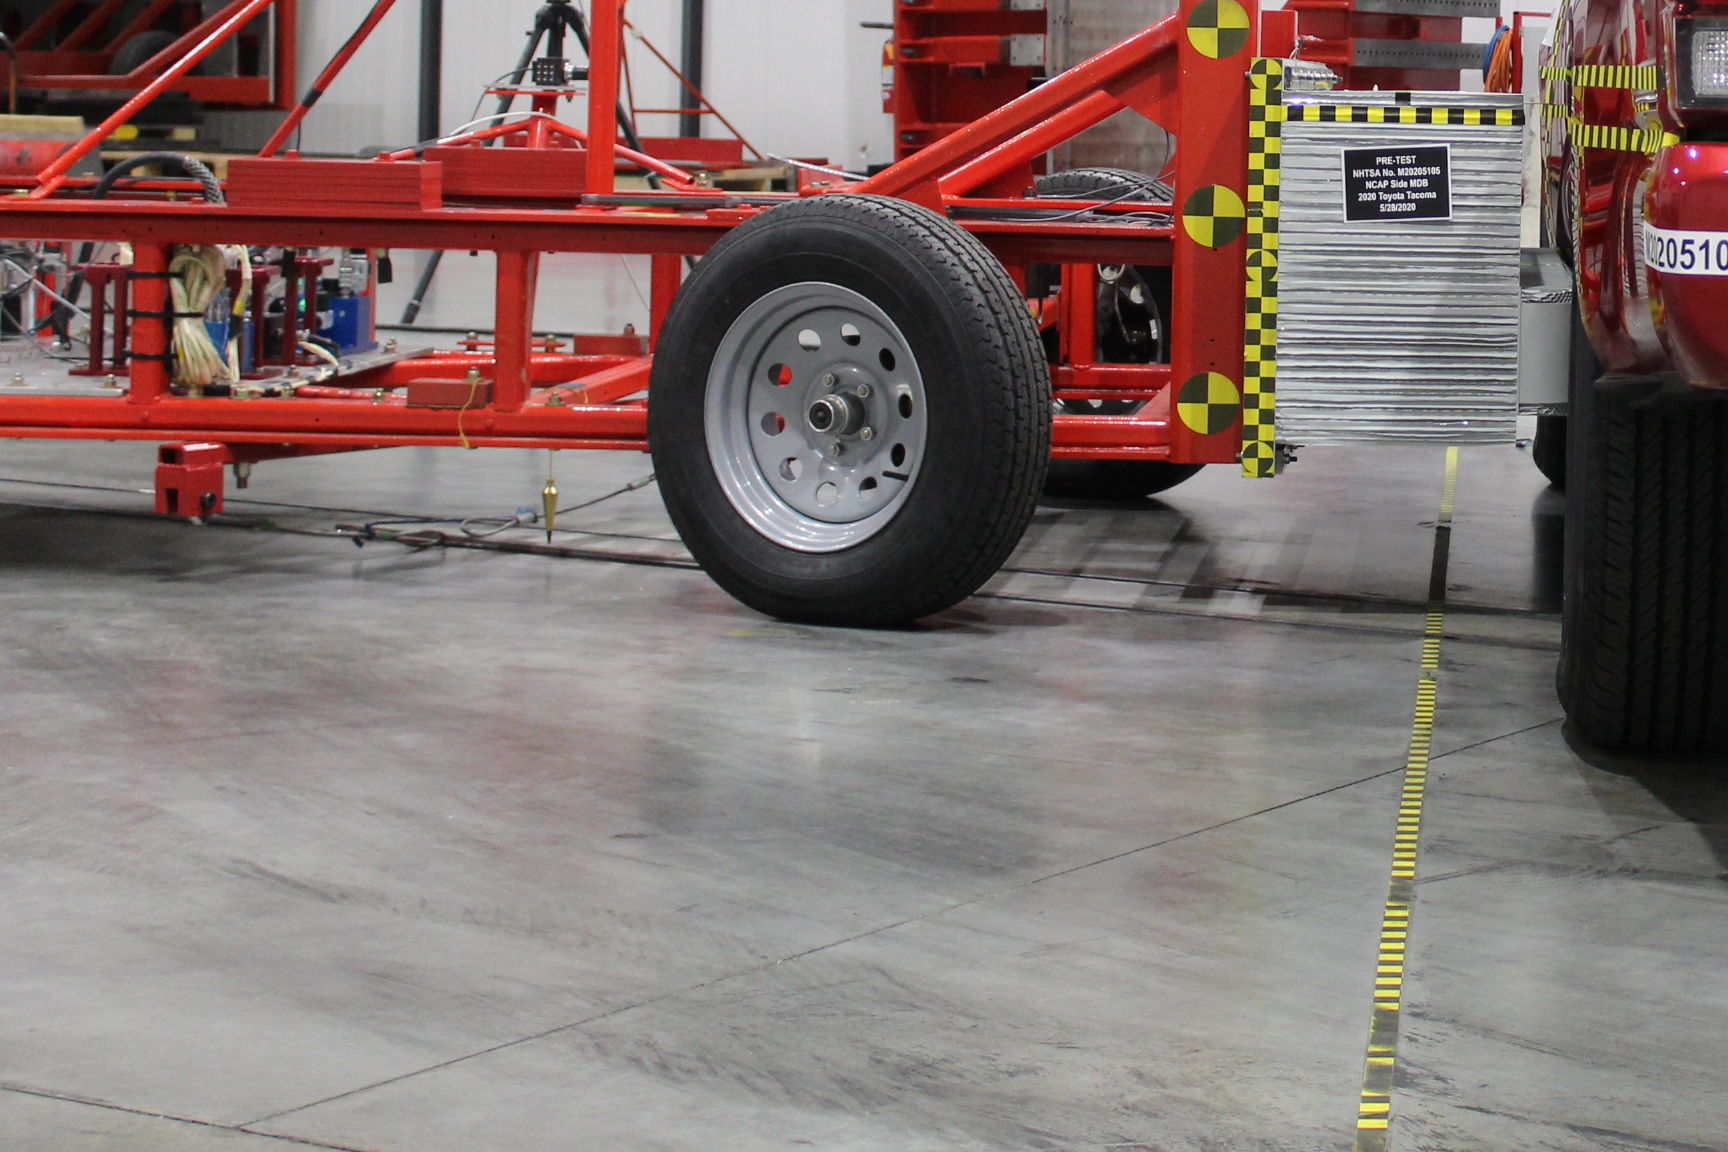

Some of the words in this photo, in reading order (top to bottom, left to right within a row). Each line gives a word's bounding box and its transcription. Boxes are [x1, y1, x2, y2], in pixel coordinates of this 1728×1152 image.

[1375, 155, 1417, 165] PRE-TEST
[1352, 169, 1381, 178] NHTSA
[1382, 168, 1396, 177] No.
[1397, 166, 1441, 176] M20205105
[1365, 180, 1389, 190] NCAP
[1390, 179, 1408, 188] Side
[1409, 178, 1429, 188] MDB
[1357, 192, 1377, 202] 2020
[1378, 191, 1405, 202] Toyota
[1406, 190, 1437, 200] Tacoma
[1379, 203, 1417, 212] 5/28/2020
